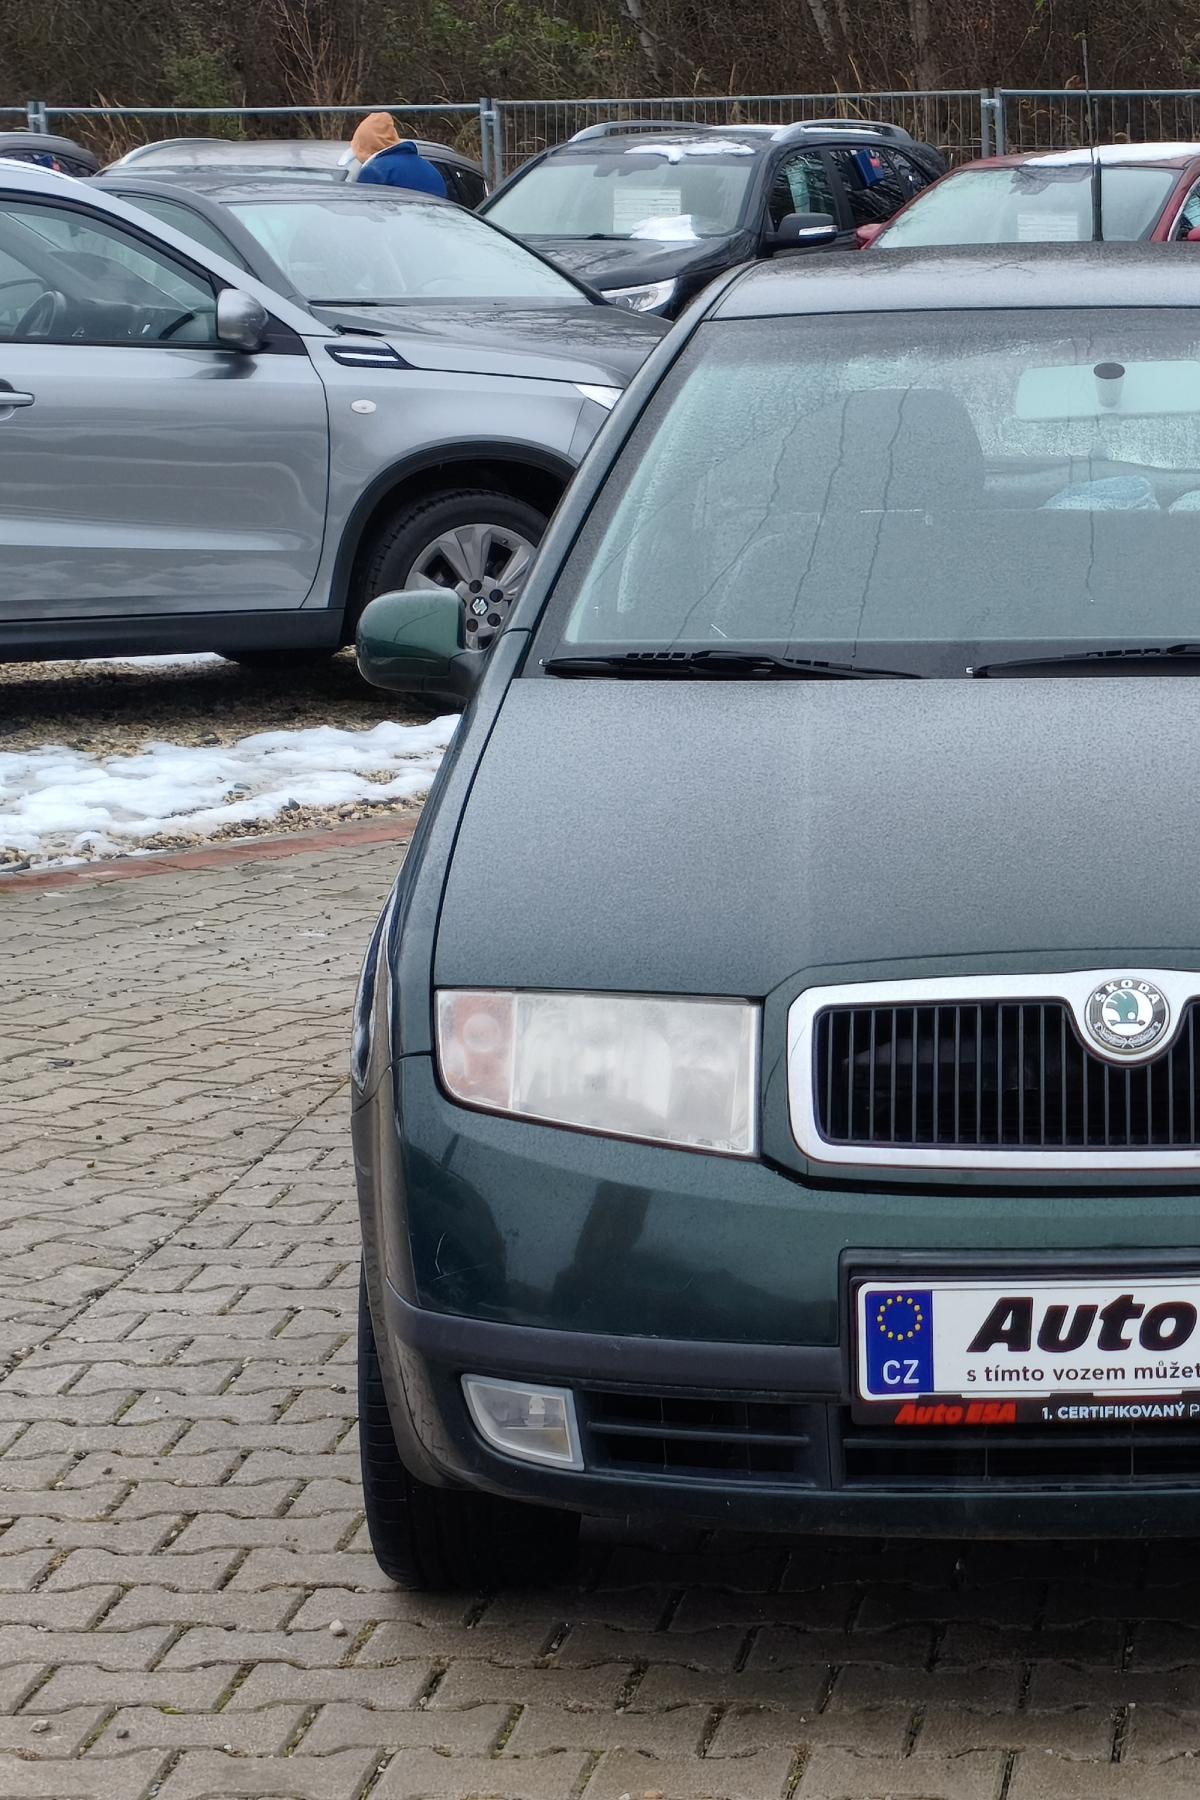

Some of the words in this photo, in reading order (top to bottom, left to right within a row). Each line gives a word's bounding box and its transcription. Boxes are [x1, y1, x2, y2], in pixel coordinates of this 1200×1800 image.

[966, 1294, 1198, 1352] Auto
[882, 1360, 920, 1384] CZ
[966, 1369, 977, 1382] s
[985, 1364, 1044, 1382] tímto
[1053, 1367, 1126, 1381] vozem
[895, 1404, 964, 1425] Auto
[965, 1403, 1017, 1423] ESA
[1042, 1407, 1053, 1419] 1.
[1057, 1401, 1185, 1420] CERTIFIKOVANÝ
